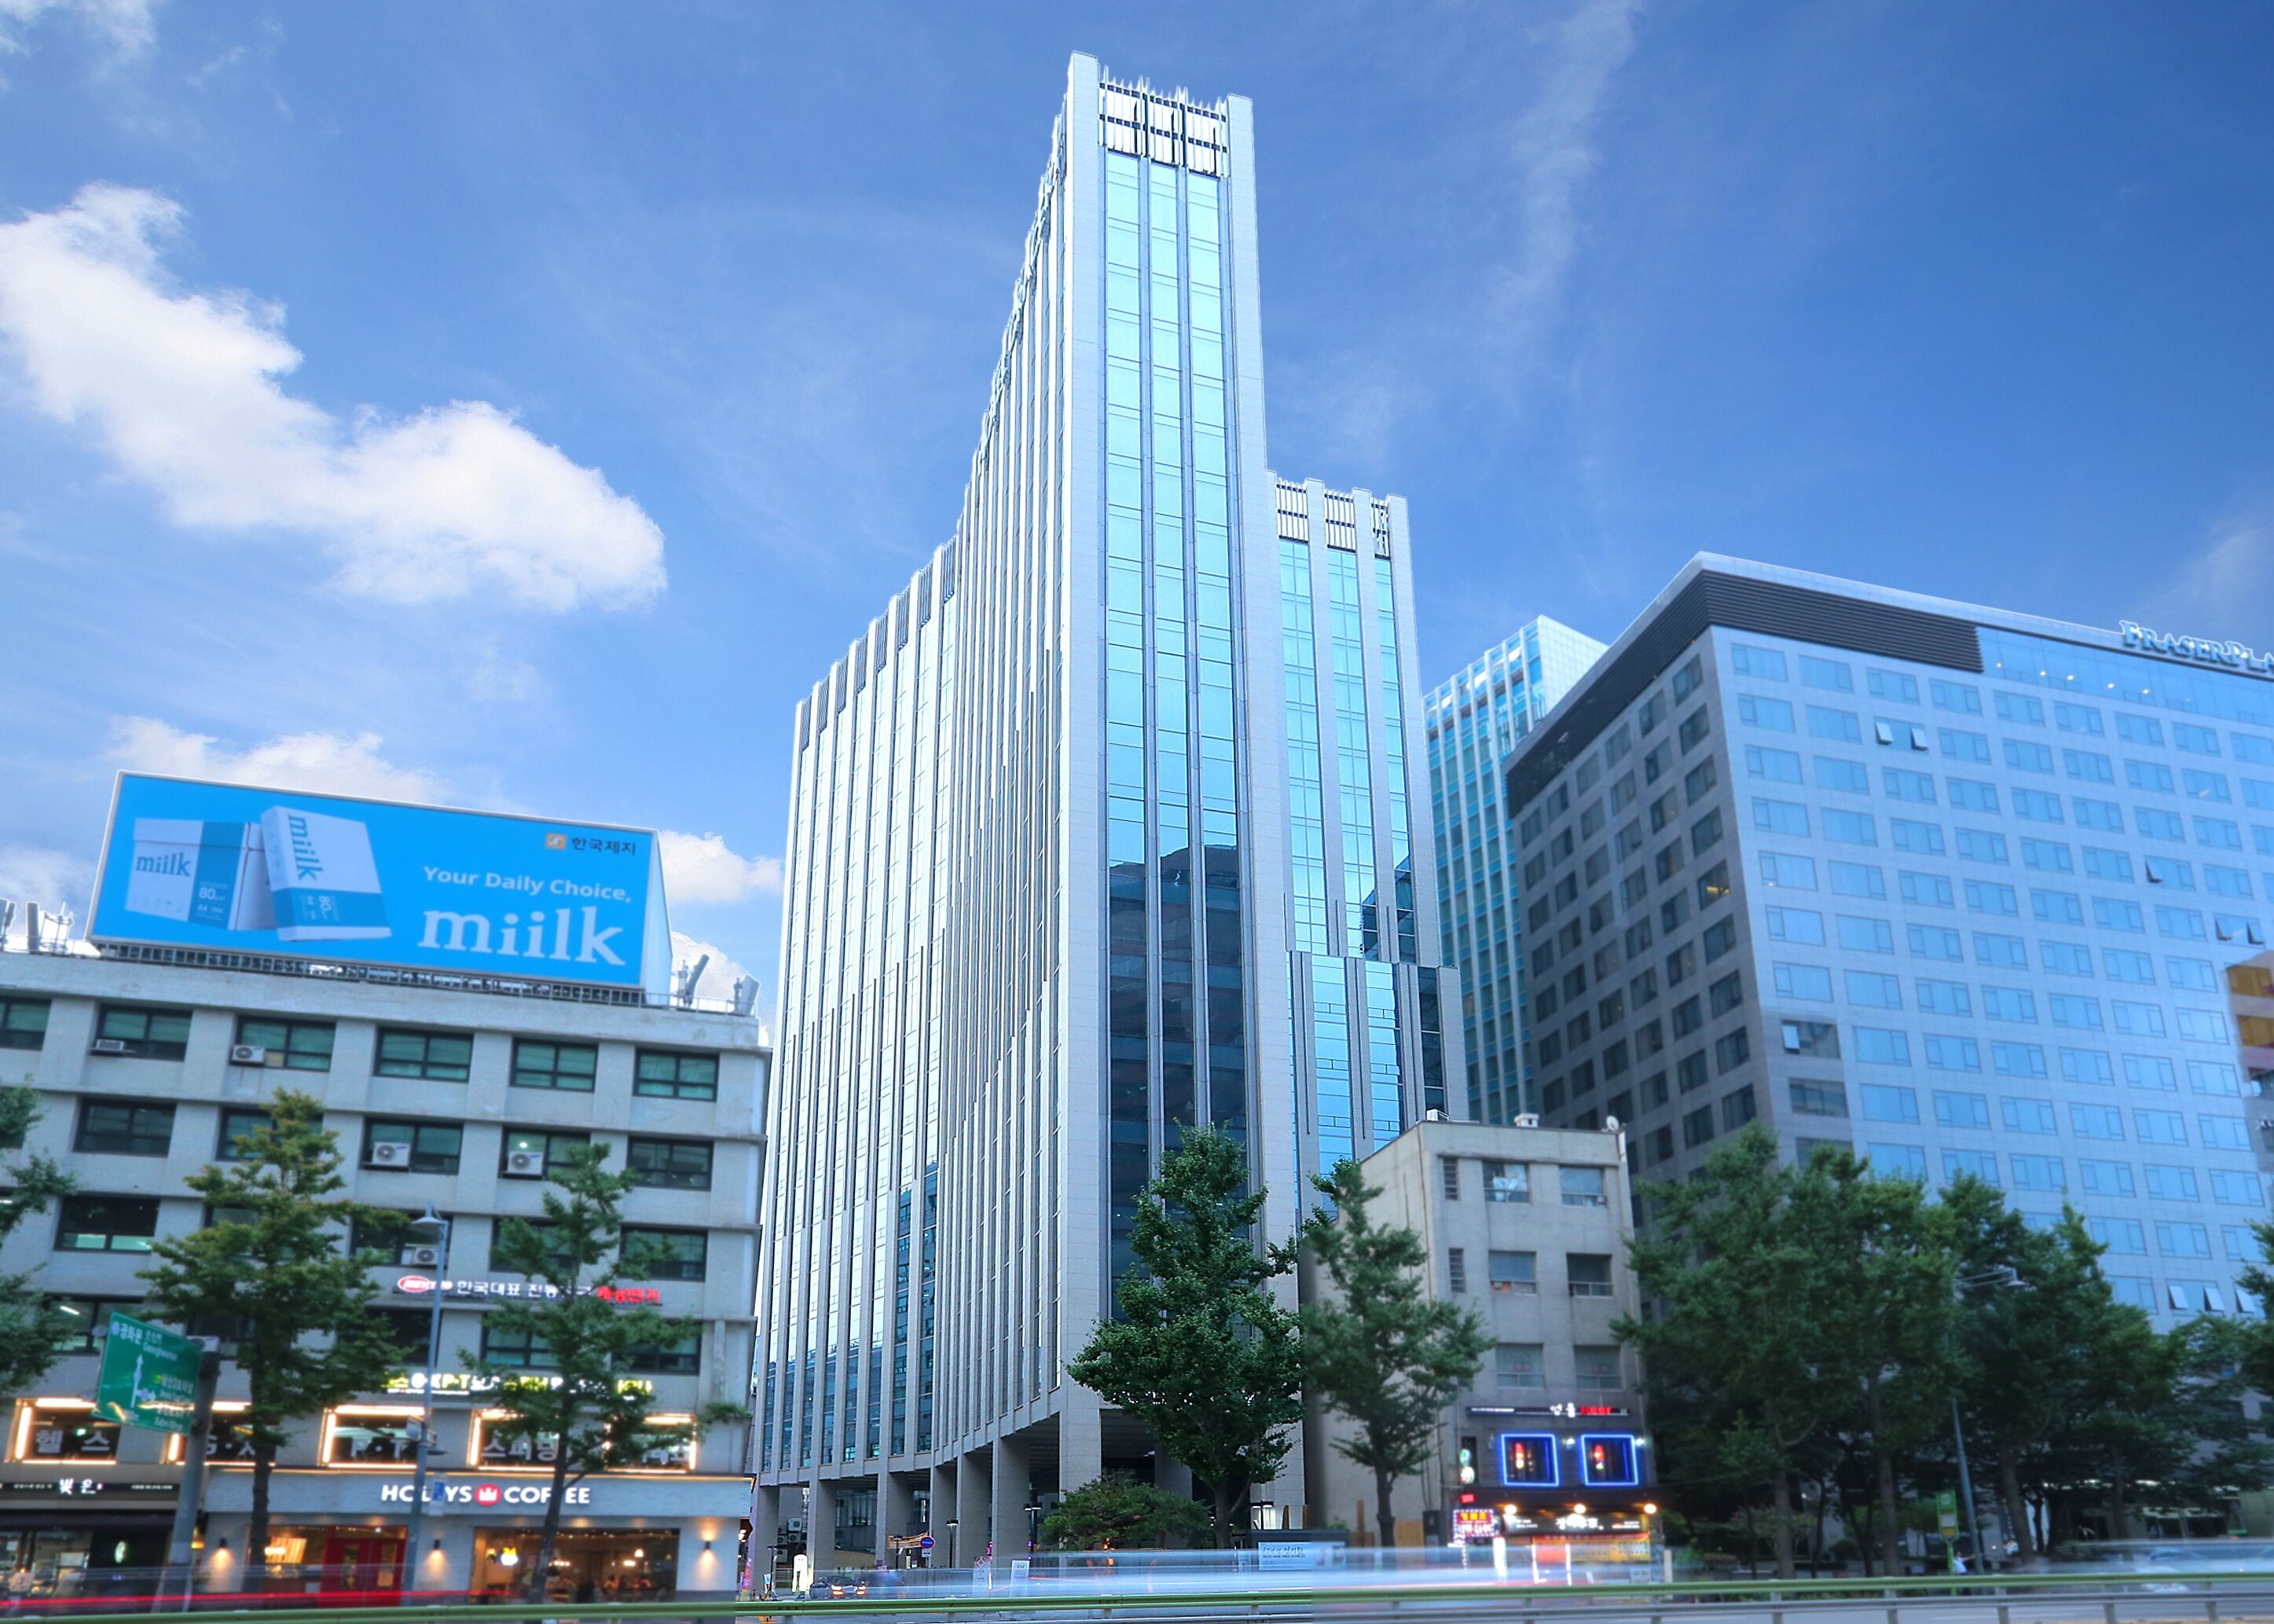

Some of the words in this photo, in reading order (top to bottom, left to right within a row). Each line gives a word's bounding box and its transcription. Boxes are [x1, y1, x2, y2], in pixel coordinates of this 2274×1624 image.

[2119, 620, 2230, 666] FRASER
[287, 814, 324, 881] miilk
[572, 837, 636, 856] 한국제지
[135, 852, 192, 878] miilk
[424, 866, 479, 885] Your
[485, 872, 545, 896] Daily
[549, 879, 632, 904] Choice,
[417, 906, 626, 966] miilk
[457, 1280, 521, 1296] 한국대표
[504, 1487, 590, 1505] COFEE
